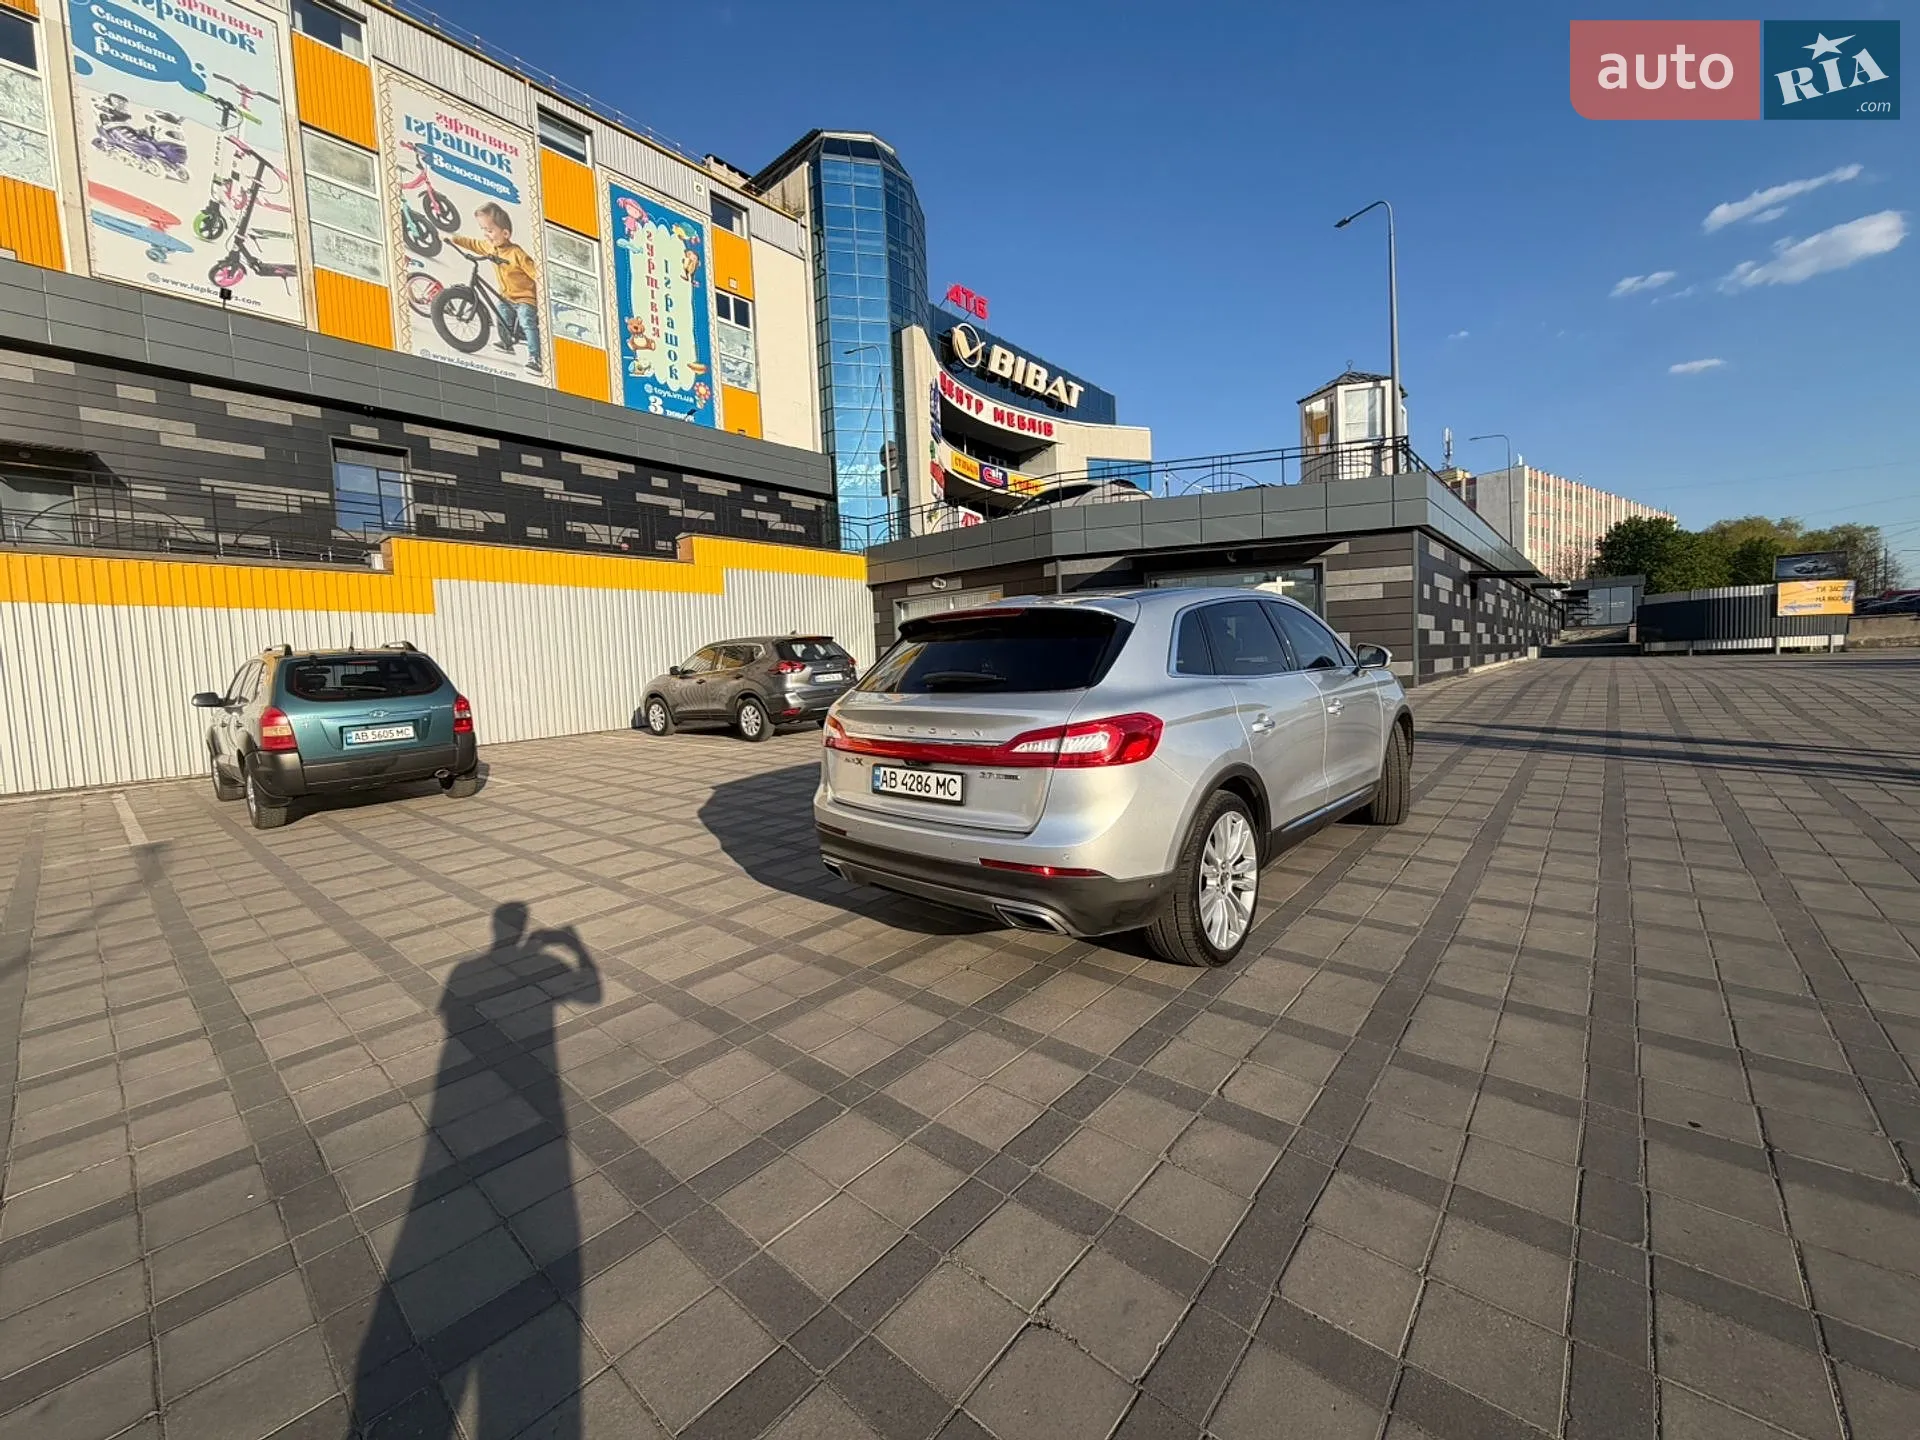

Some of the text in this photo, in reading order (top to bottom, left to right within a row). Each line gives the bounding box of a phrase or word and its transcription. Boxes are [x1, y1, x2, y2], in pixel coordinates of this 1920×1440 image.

[92, 22, 177, 65] Самокати
[94, 36, 158, 73] Ролики
[432, 152, 511, 195] Велосипеди
[648, 395, 664, 415] 3
[940, 371, 1054, 437] ЦЕНТР МЕБЛІВ
[355, 732, 369, 741] AB
[881, 770, 957, 797] AB 4286 MC
